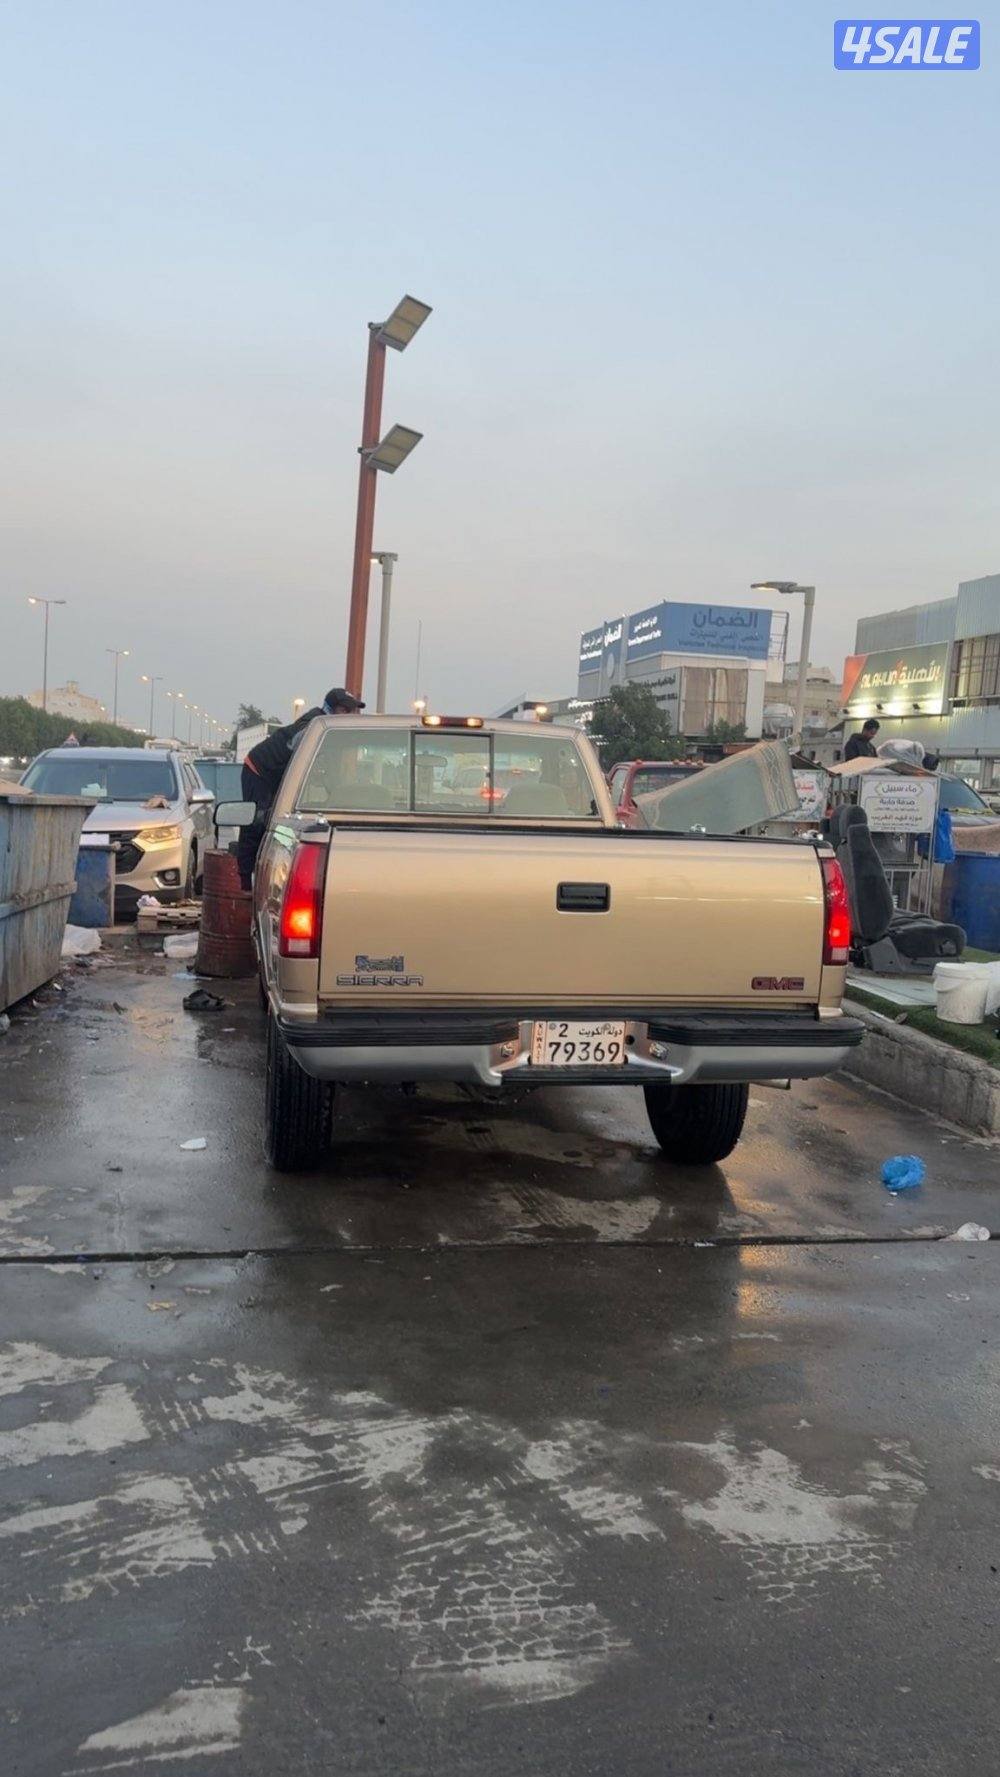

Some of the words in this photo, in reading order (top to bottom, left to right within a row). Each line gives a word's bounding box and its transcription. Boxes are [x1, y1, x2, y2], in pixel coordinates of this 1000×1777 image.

[693, 608, 758, 628] الضمان
[882, 784, 904, 793] سبيل
[905, 784, 917, 793] ماء
[336, 974, 424, 987] SIERRA
[751, 976, 805, 990] GMC
[558, 1022, 569, 1038] 2
[578, 1025, 606, 1038] الكويت
[548, 1041, 621, 1063] 79369
